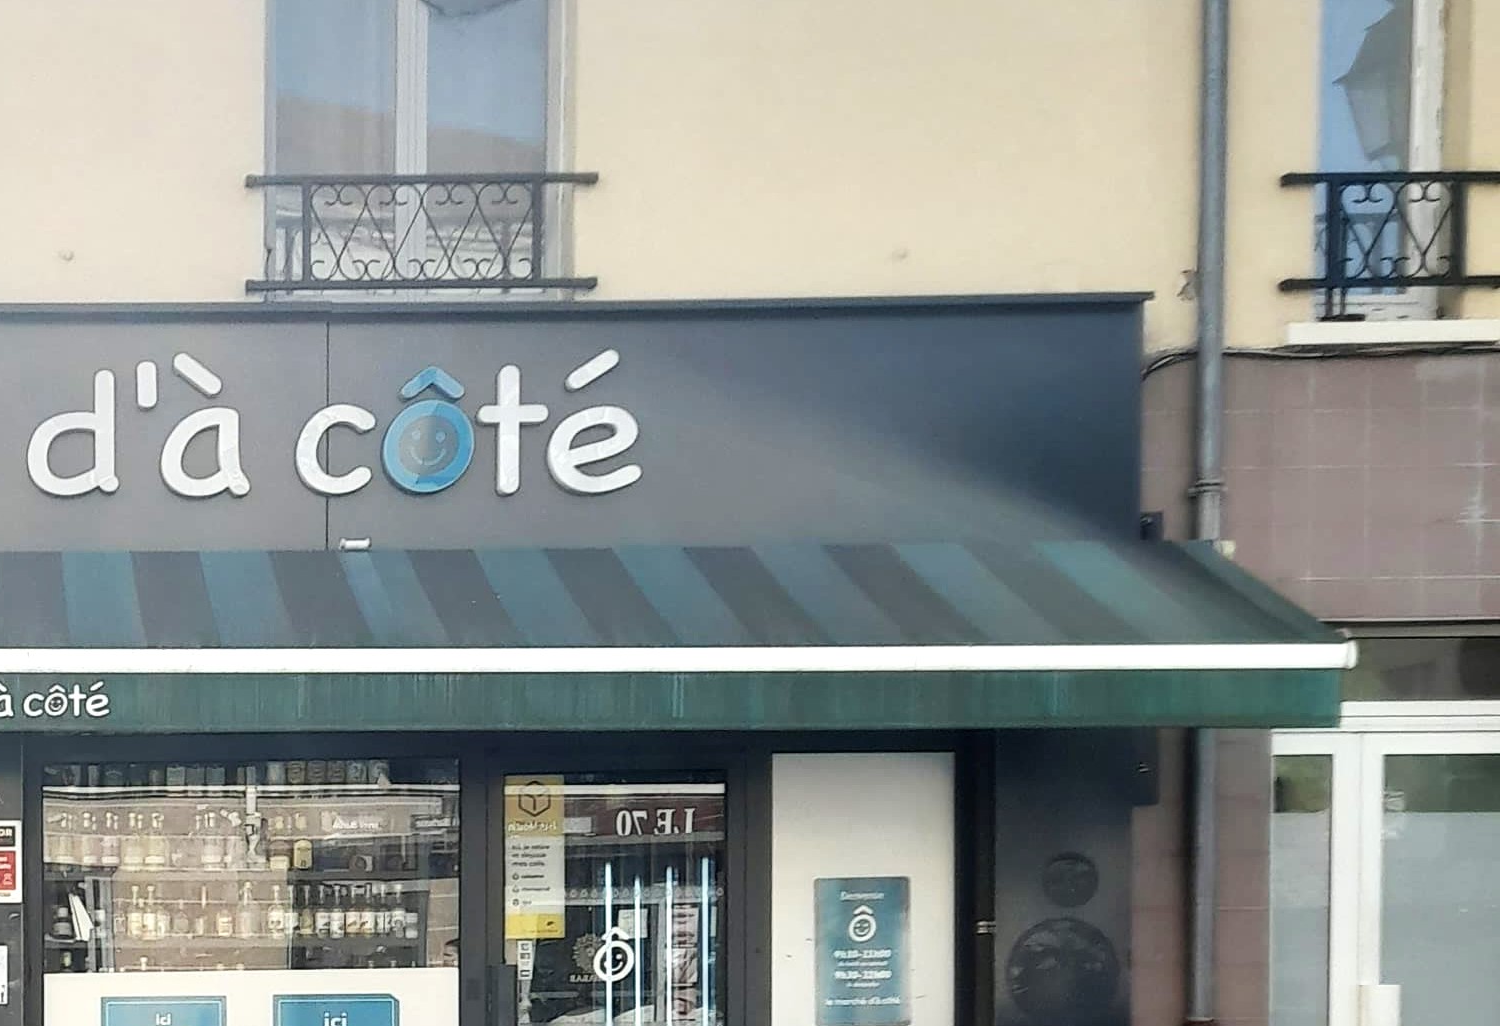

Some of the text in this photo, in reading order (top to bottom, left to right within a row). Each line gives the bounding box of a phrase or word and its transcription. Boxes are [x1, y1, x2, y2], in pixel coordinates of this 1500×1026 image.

[26, 352, 251, 500] d'à
[294, 348, 643, 499] côté
[23, 681, 110, 718] côté
[155, 1013, 171, 1026] ici
